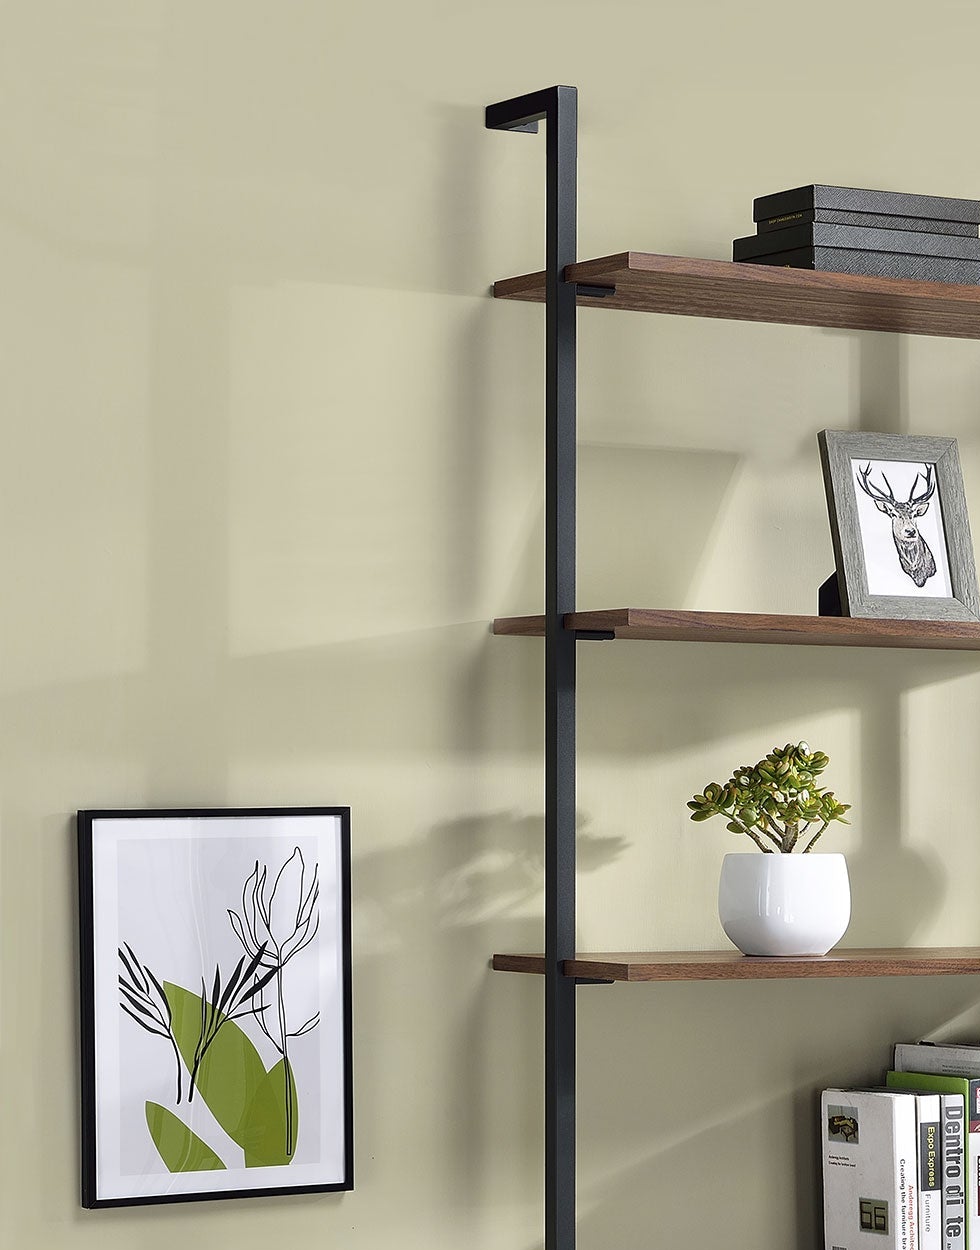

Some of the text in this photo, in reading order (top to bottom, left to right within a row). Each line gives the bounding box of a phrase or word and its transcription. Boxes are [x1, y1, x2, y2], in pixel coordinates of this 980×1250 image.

[927, 1126, 936, 1187] Expo Express
[945, 1105, 964, 1238] Dentro di te
[860, 1201, 886, 1231] 66
[924, 1193, 932, 1233] Furniture
